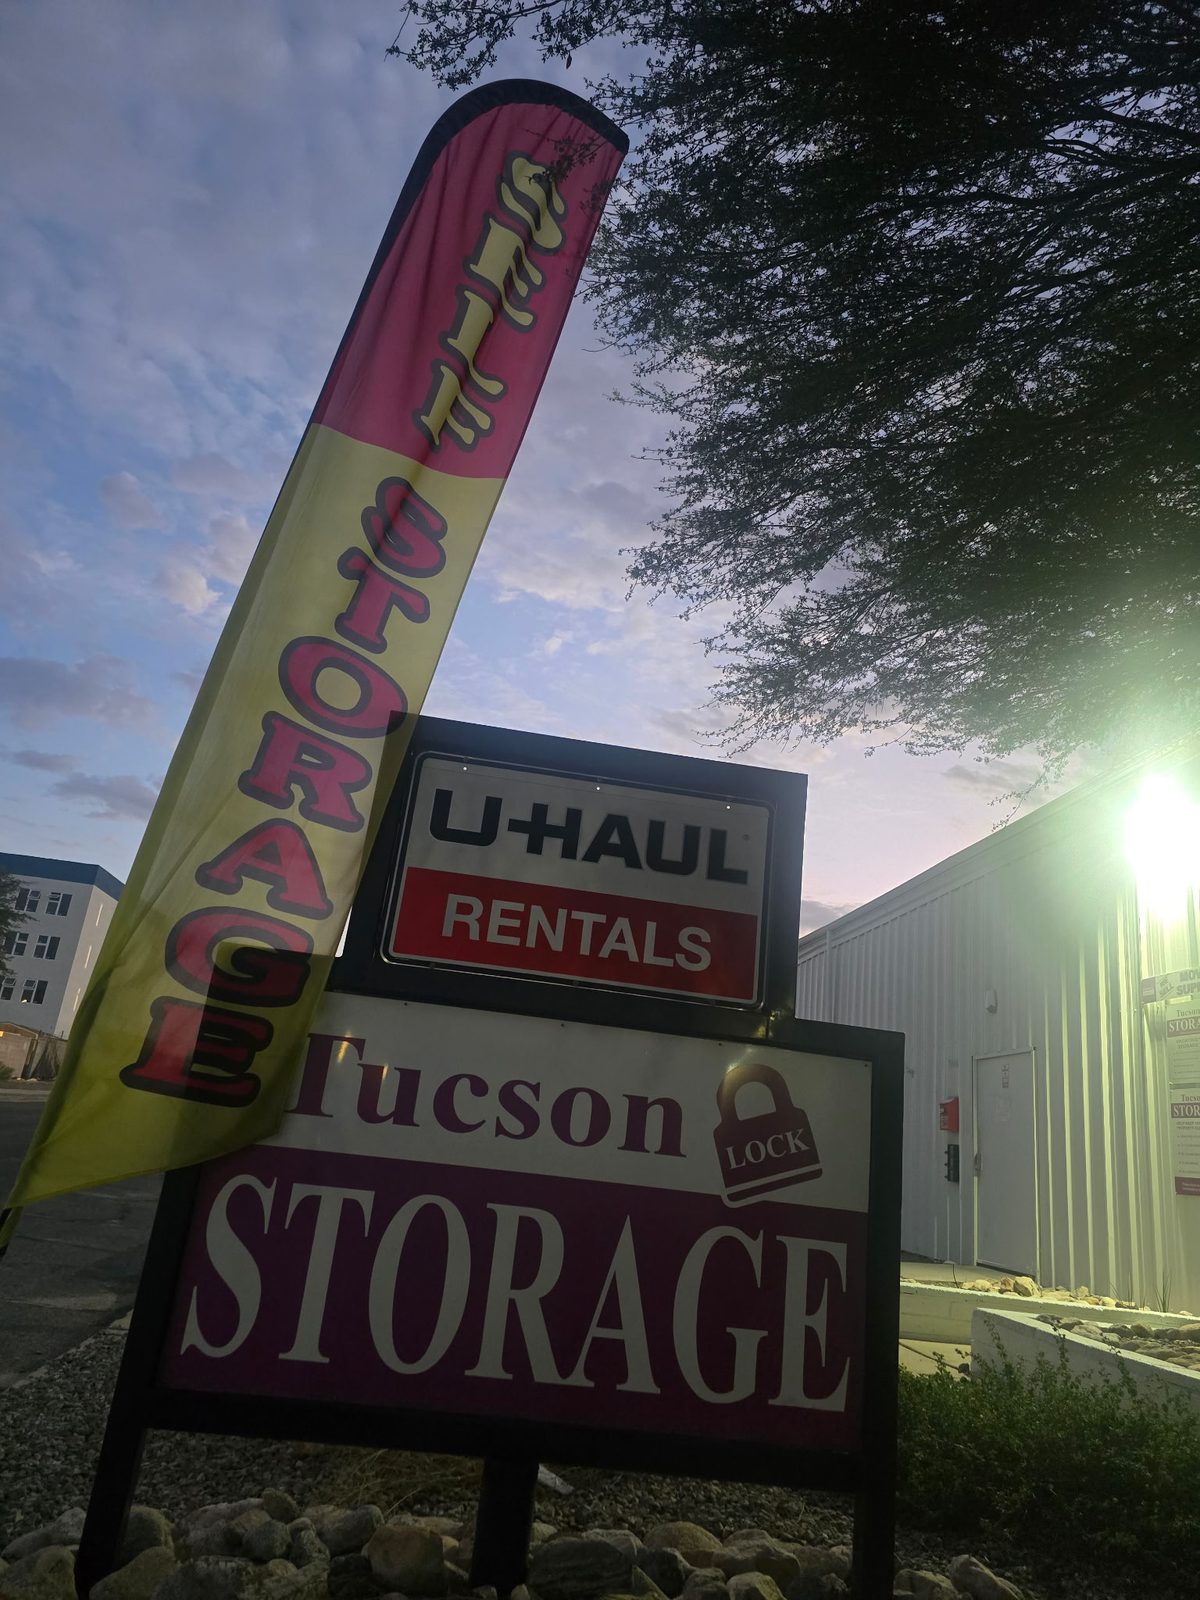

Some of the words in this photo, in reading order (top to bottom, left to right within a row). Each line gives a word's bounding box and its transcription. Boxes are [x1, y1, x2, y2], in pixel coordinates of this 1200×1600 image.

[412, 152, 568, 453] SELF
[119, 476, 448, 1108] STORAGE
[441, 893, 712, 972] RENTALS
[285, 1032, 687, 1159] Tucson
[725, 1128, 811, 1170] LOCK
[180, 1174, 851, 1413] STORAGE
